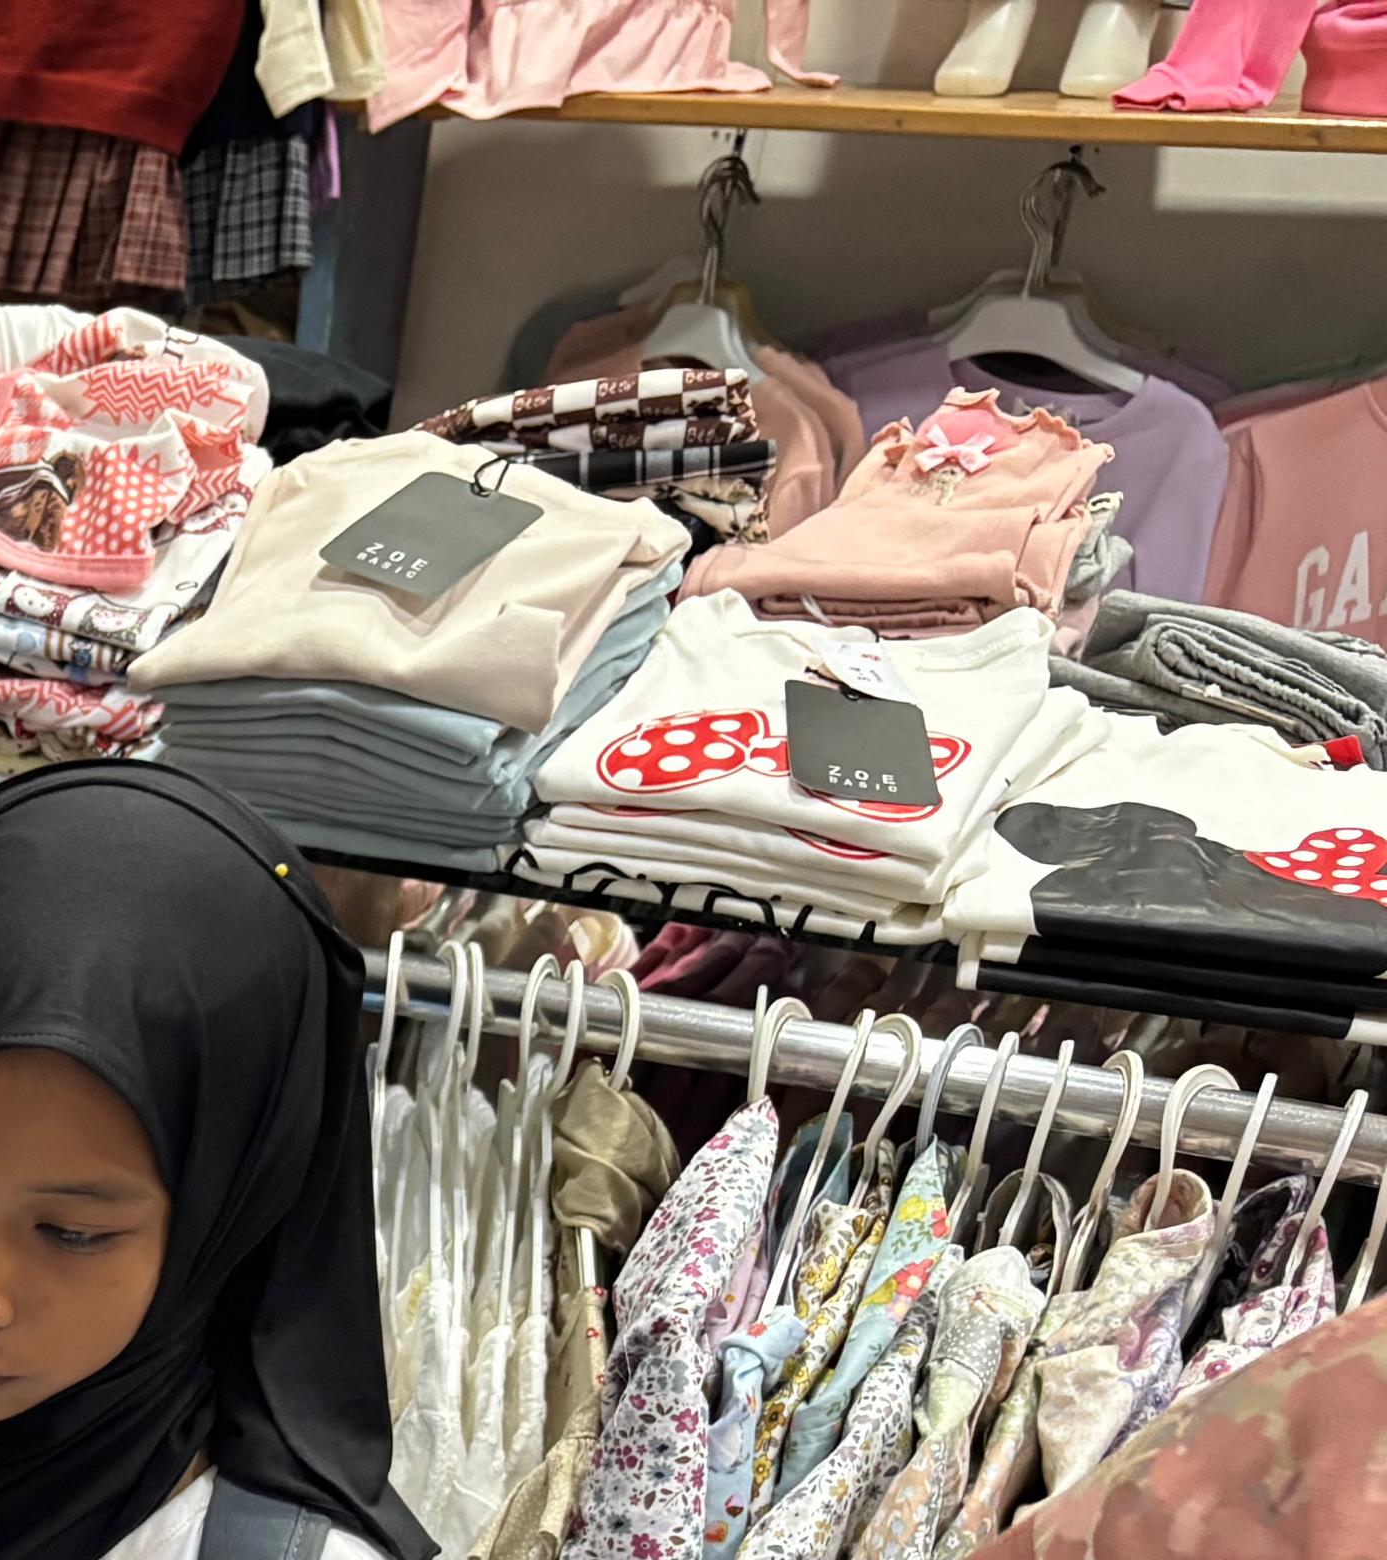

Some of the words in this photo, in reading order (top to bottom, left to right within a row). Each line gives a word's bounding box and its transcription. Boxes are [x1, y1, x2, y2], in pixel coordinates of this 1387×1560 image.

[356, 552, 417, 579] BASIC
[365, 542, 428, 572] ZOE
[1293, 528, 1387, 629] GA
[828, 764, 896, 785] ZOE
[829, 775, 898, 793] BASIC
